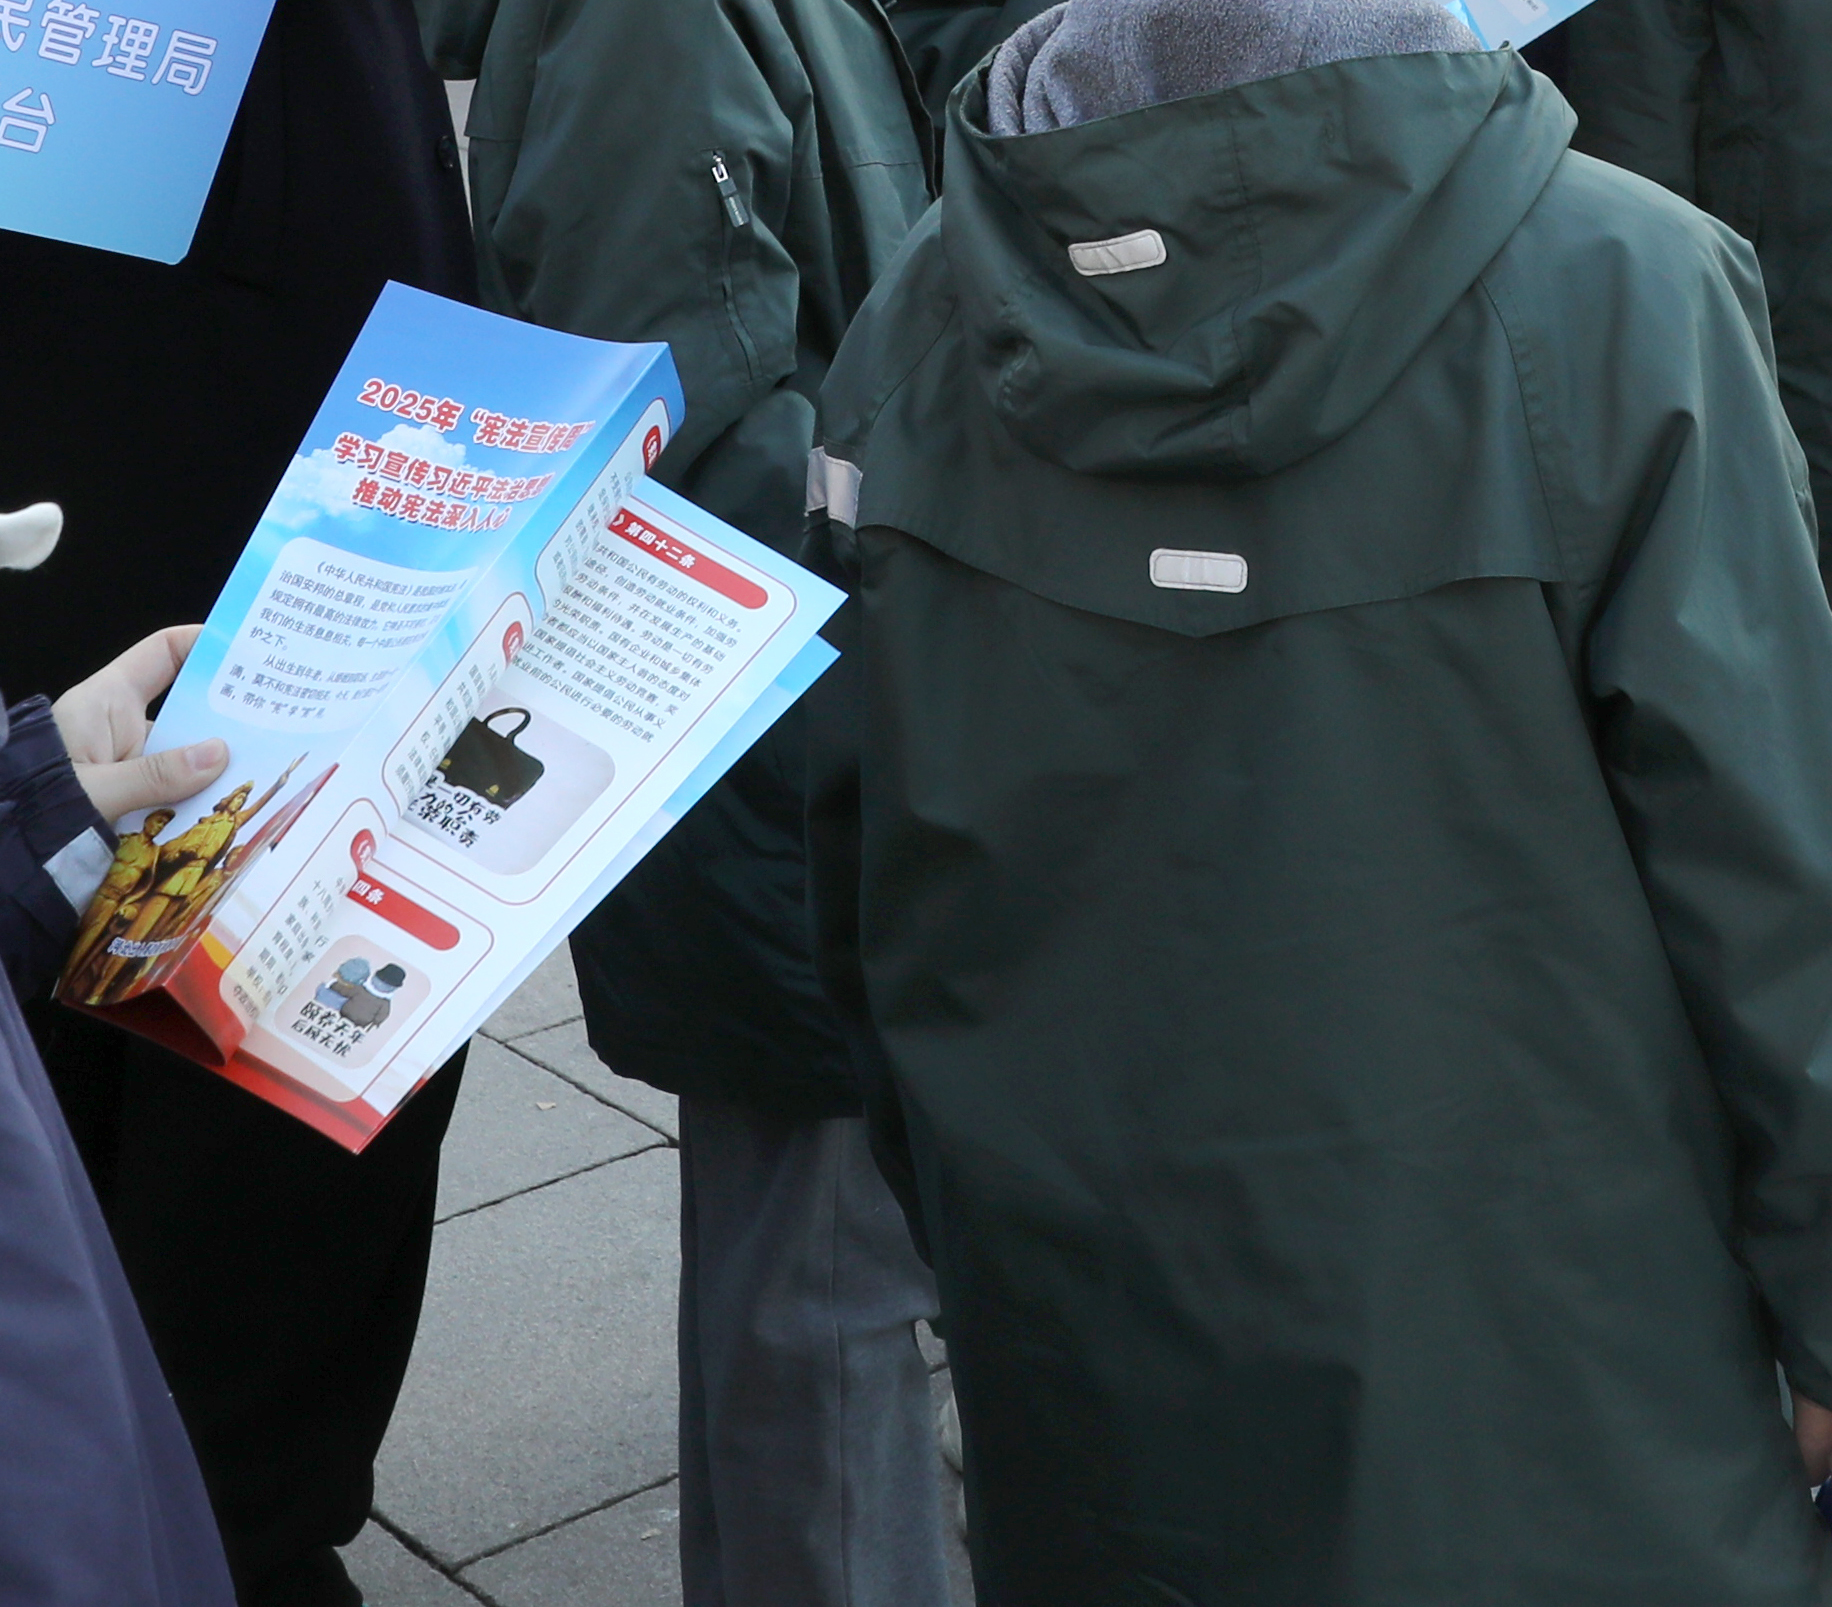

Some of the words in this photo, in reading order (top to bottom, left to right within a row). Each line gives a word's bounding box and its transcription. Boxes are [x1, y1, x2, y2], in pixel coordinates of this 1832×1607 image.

[351, 476, 513, 533] 推动宪法深入人心
[584, 556, 739, 649] 途径，创造劳动就业条件，加强劳
[249, 625, 289, 652] 护之下。
